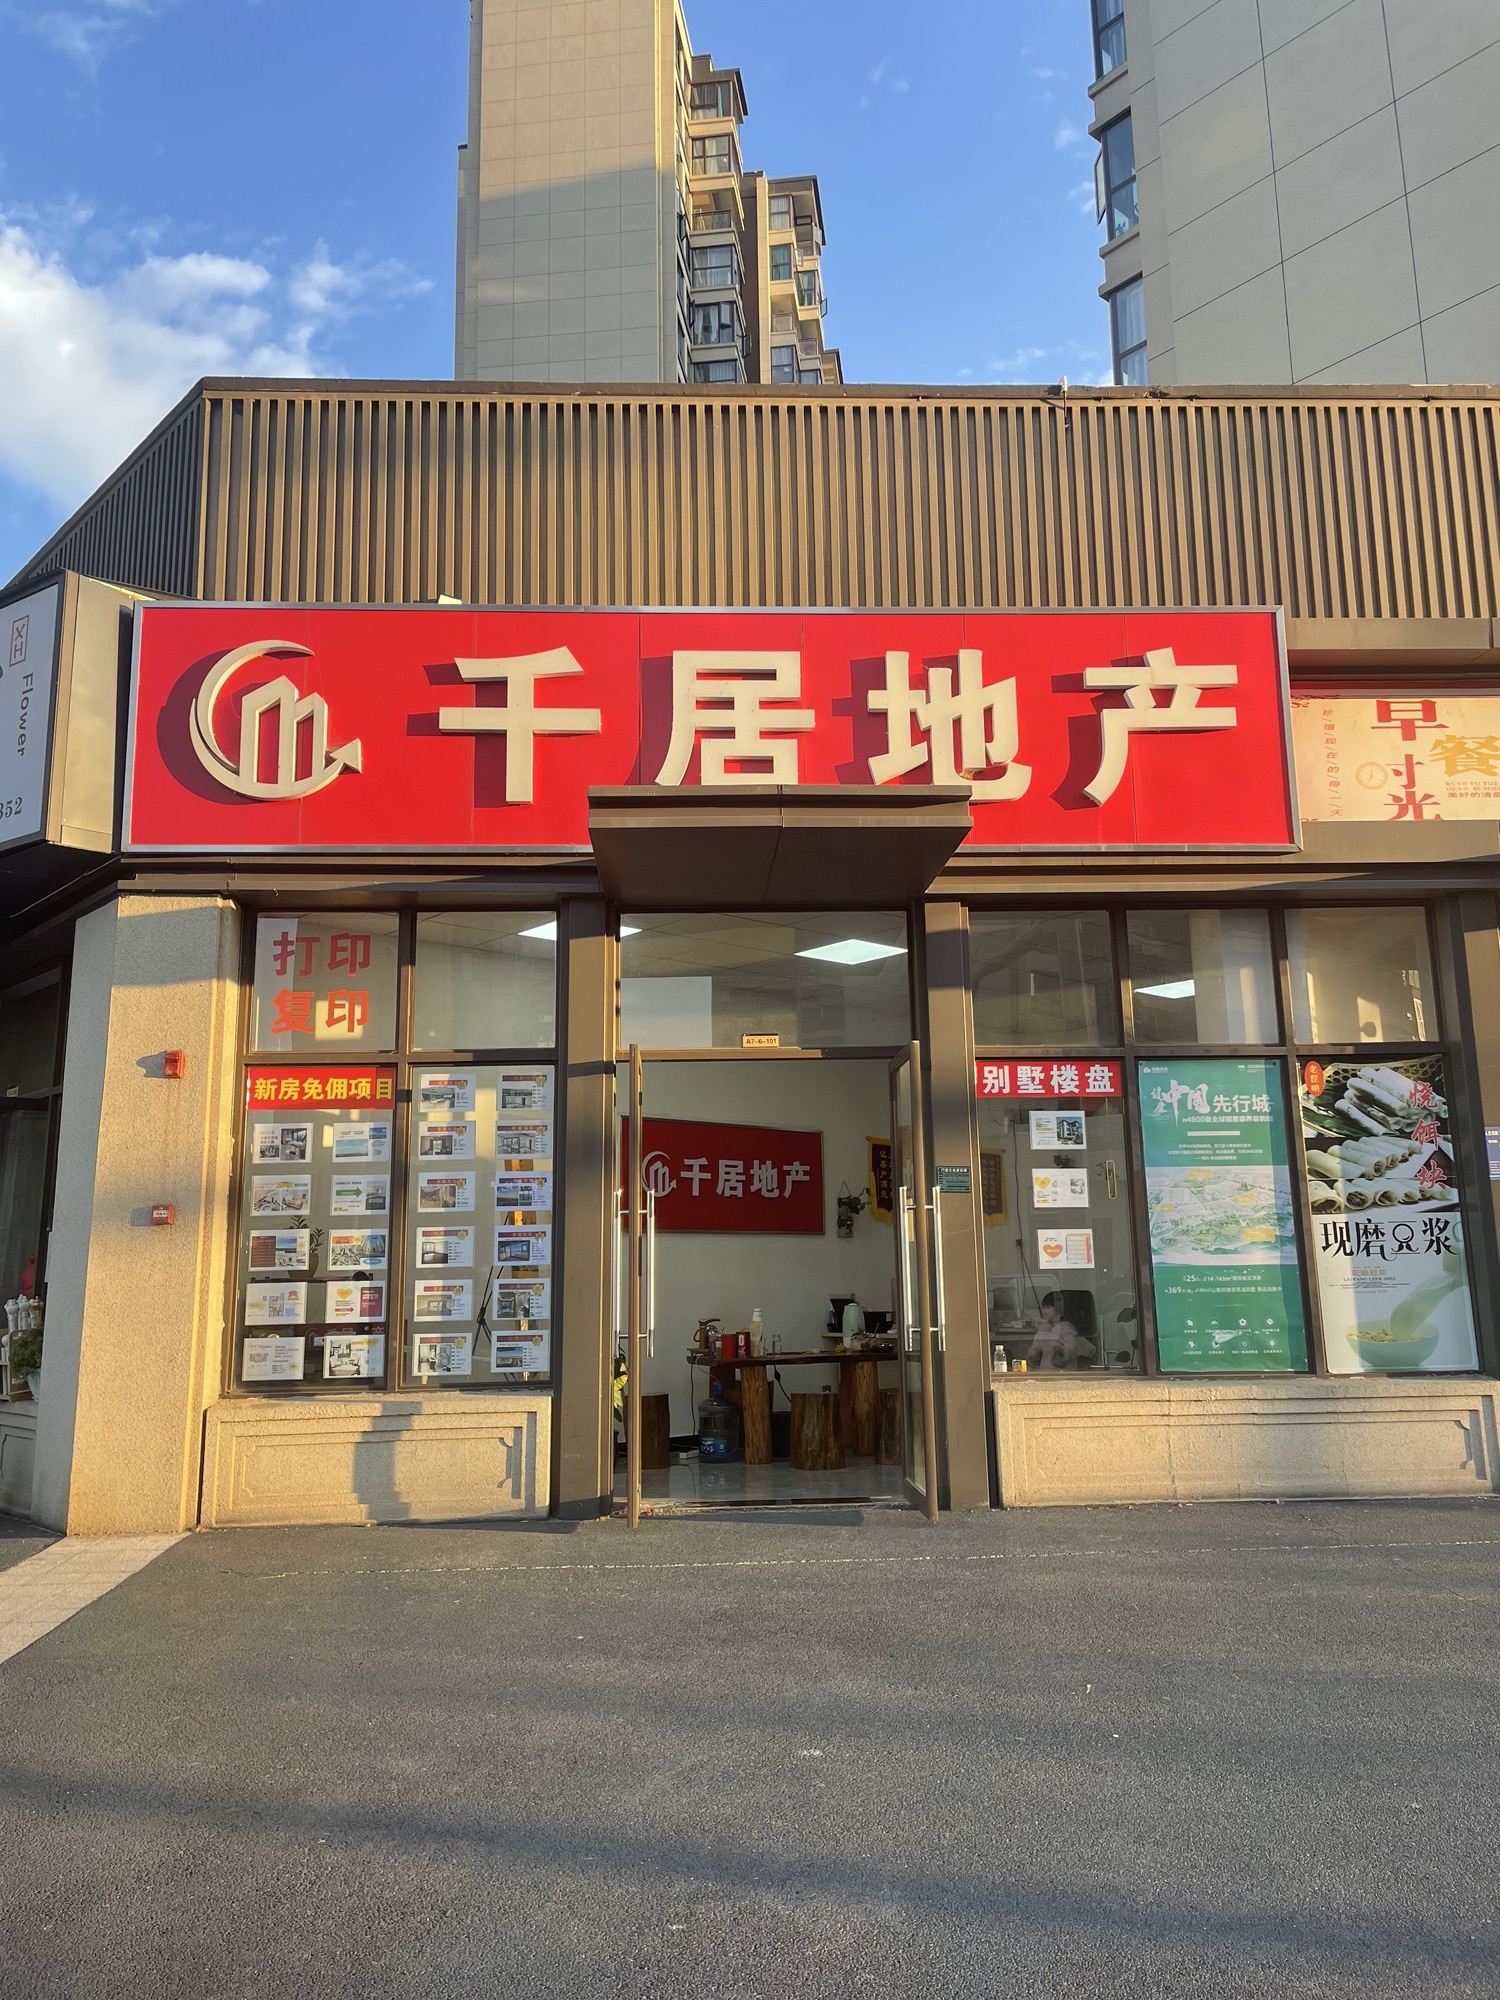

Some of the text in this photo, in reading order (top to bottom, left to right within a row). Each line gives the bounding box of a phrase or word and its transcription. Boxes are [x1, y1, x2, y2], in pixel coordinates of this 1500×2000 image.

[17, 672, 34, 757] Flower
[438, 644, 1239, 806] 千居地产
[272, 931, 371, 977] 打印
[270, 988, 369, 1034] 复印
[253, 1077, 393, 1101] 新房免佣项目
[982, 1064, 1115, 1095] 别墅楼盘
[1409, 1081, 1448, 1190] 烧饵块
[680, 1157, 810, 1199] 千居地产
[1320, 1217, 1458, 1262] 现磨豆浆
